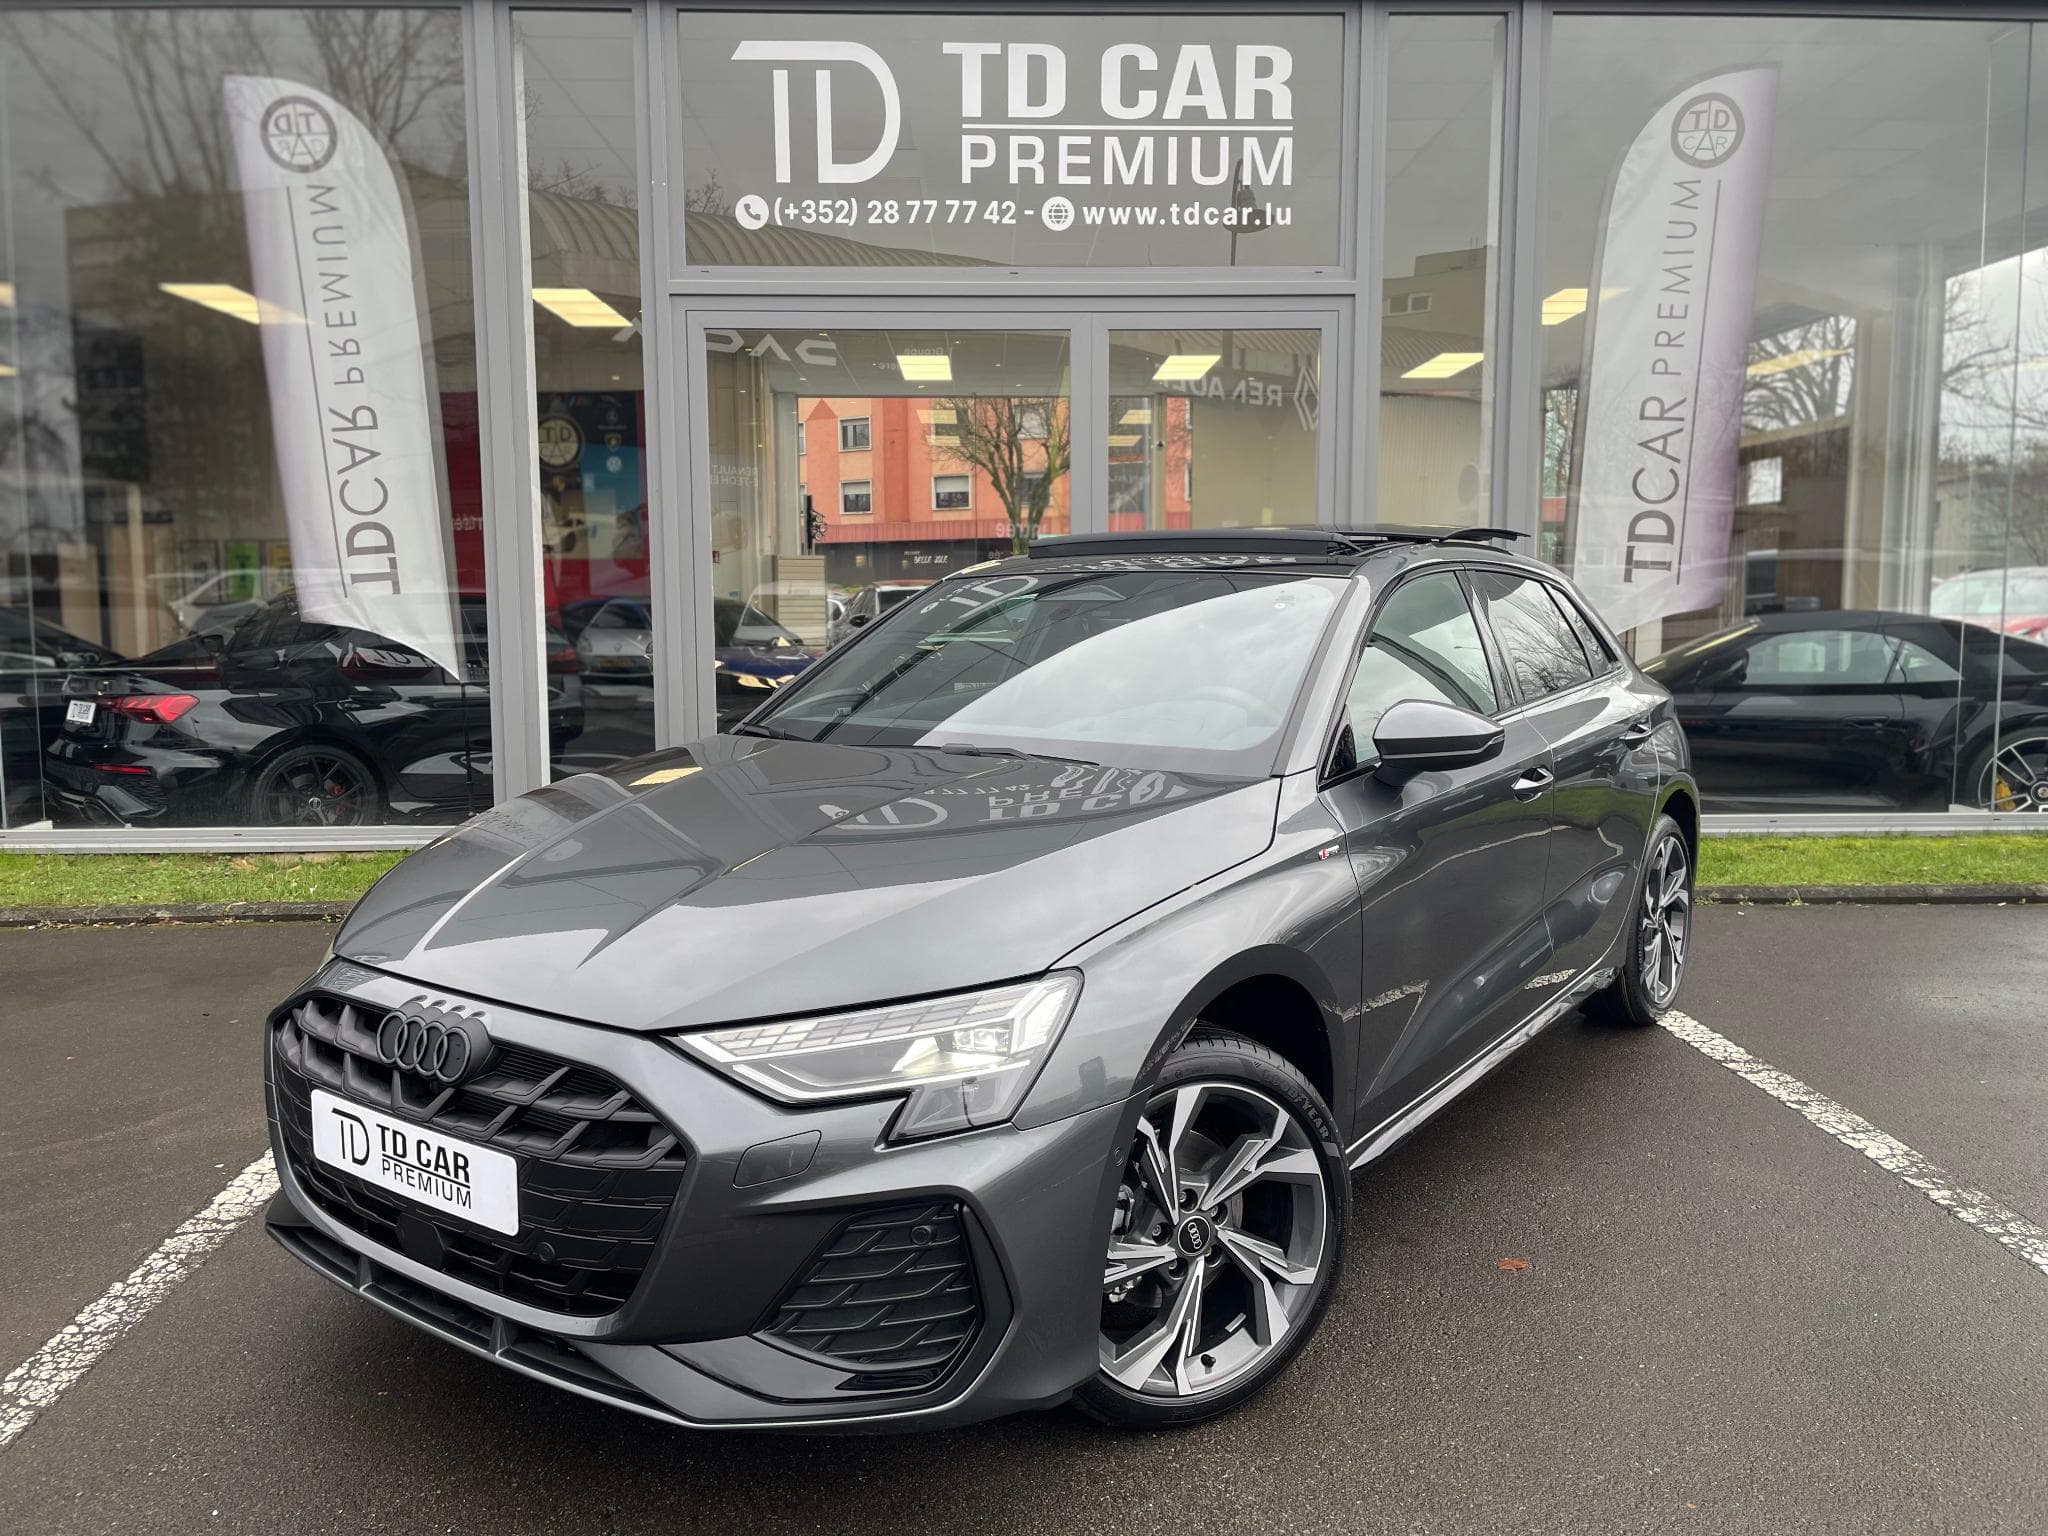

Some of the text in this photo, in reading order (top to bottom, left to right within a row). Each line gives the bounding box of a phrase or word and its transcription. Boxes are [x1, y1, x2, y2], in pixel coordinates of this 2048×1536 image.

[942, 41, 1294, 121] TD CAR
[1682, 131, 1728, 158] CAR
[1689, 109, 1730, 130] TD
[961, 134, 1294, 186] PREMIUM
[774, 197, 858, 226] (+352)
[867, 200, 900, 224] 28
[906, 200, 938, 224] 77
[945, 200, 978, 224] 77
[983, 200, 1017, 225] 42
[1082, 201, 1293, 226] www.tdcar.lu
[1623, 179, 1702, 583] TDCAR PREMIUM
[376, 1123, 471, 1184] TD CAR
[381, 1157, 472, 1210] PREMIUM
